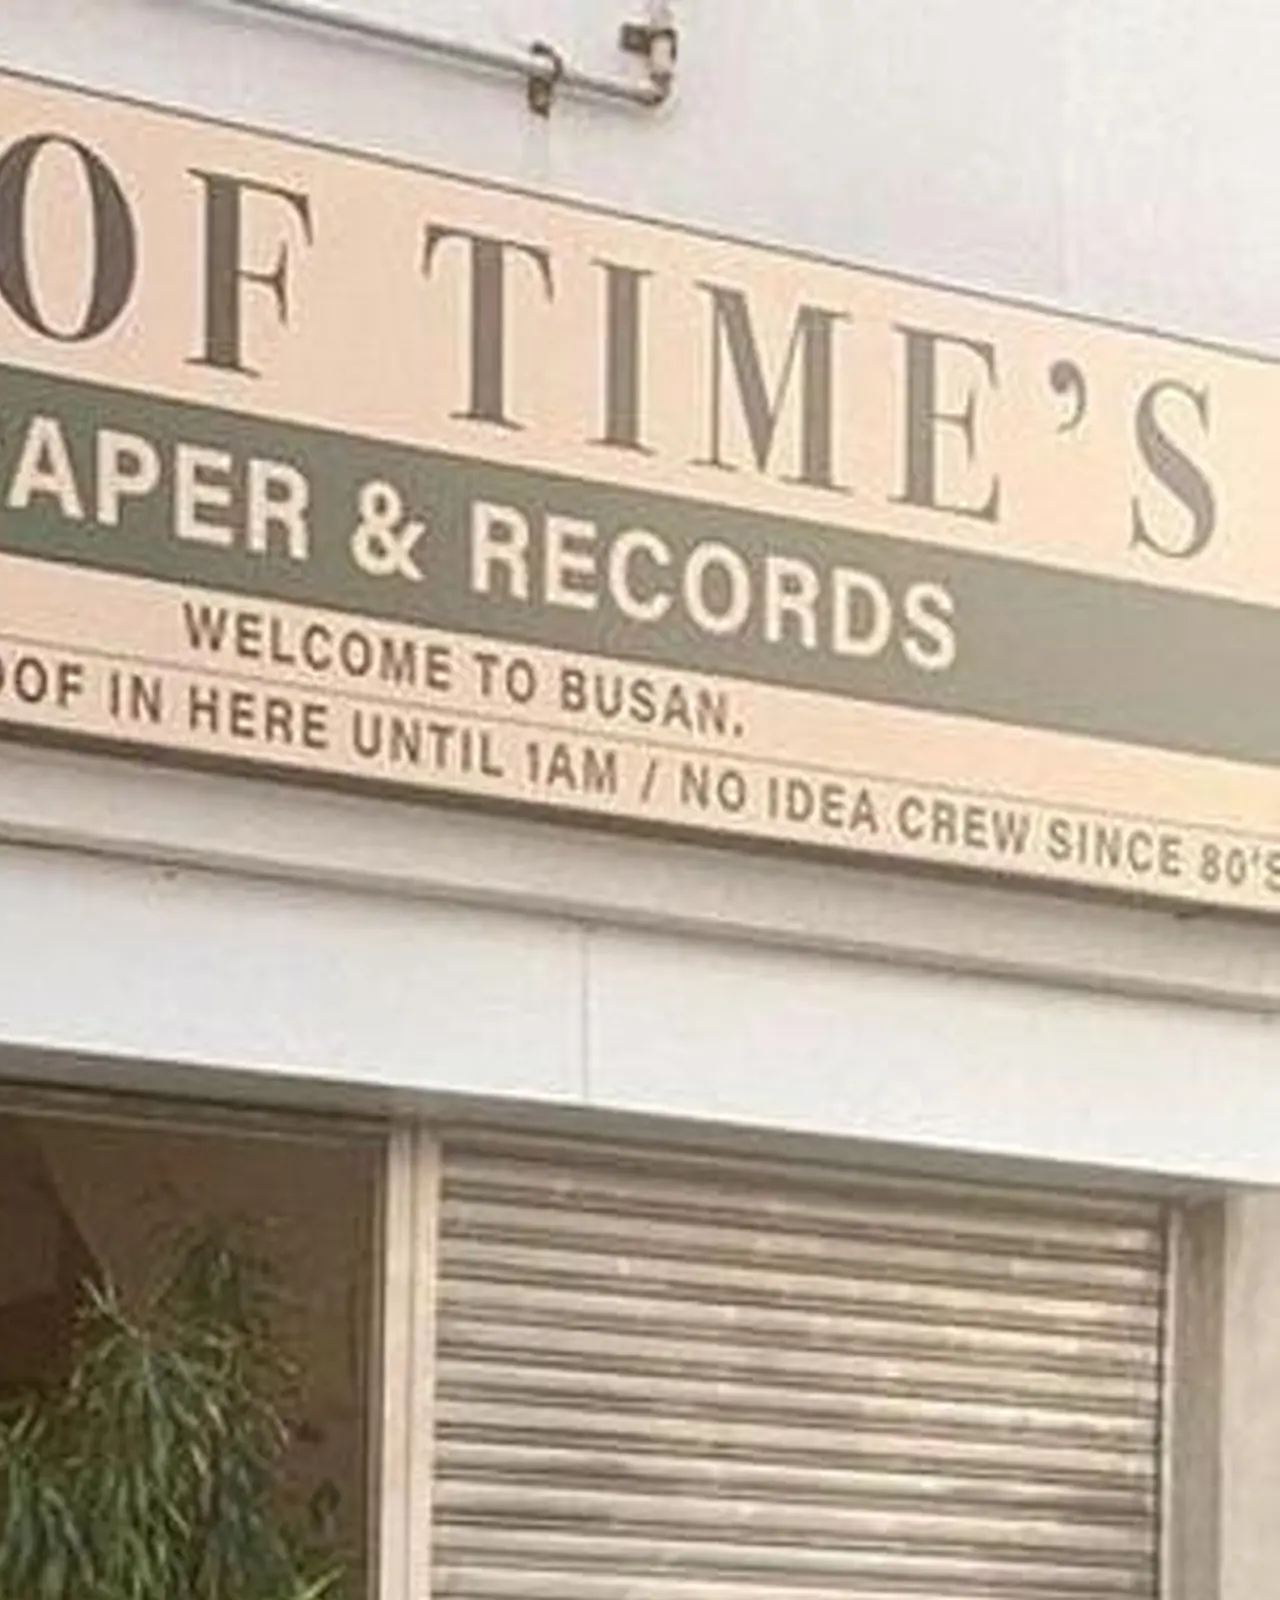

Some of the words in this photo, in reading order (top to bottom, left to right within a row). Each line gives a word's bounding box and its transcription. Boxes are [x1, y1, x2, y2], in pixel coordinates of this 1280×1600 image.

[420, 222, 1219, 561] TIME’S
[183, 601, 453, 693] WELCOME
[473, 653, 539, 705] TO
[559, 668, 748, 742] BUSAN.
[351, 479, 427, 582] &
[469, 500, 960, 674] RECORDS
[109, 673, 163, 725] IN
[188, 688, 330, 751] HERE
[352, 709, 505, 780] UNTIL
[524, 739, 620, 798] 1AM
[639, 754, 660, 804] /
[681, 766, 750, 816] NO
[770, 778, 881, 836] IDEA
[897, 796, 1032, 855] CREW
[1047, 816, 1184, 878] SINCE
